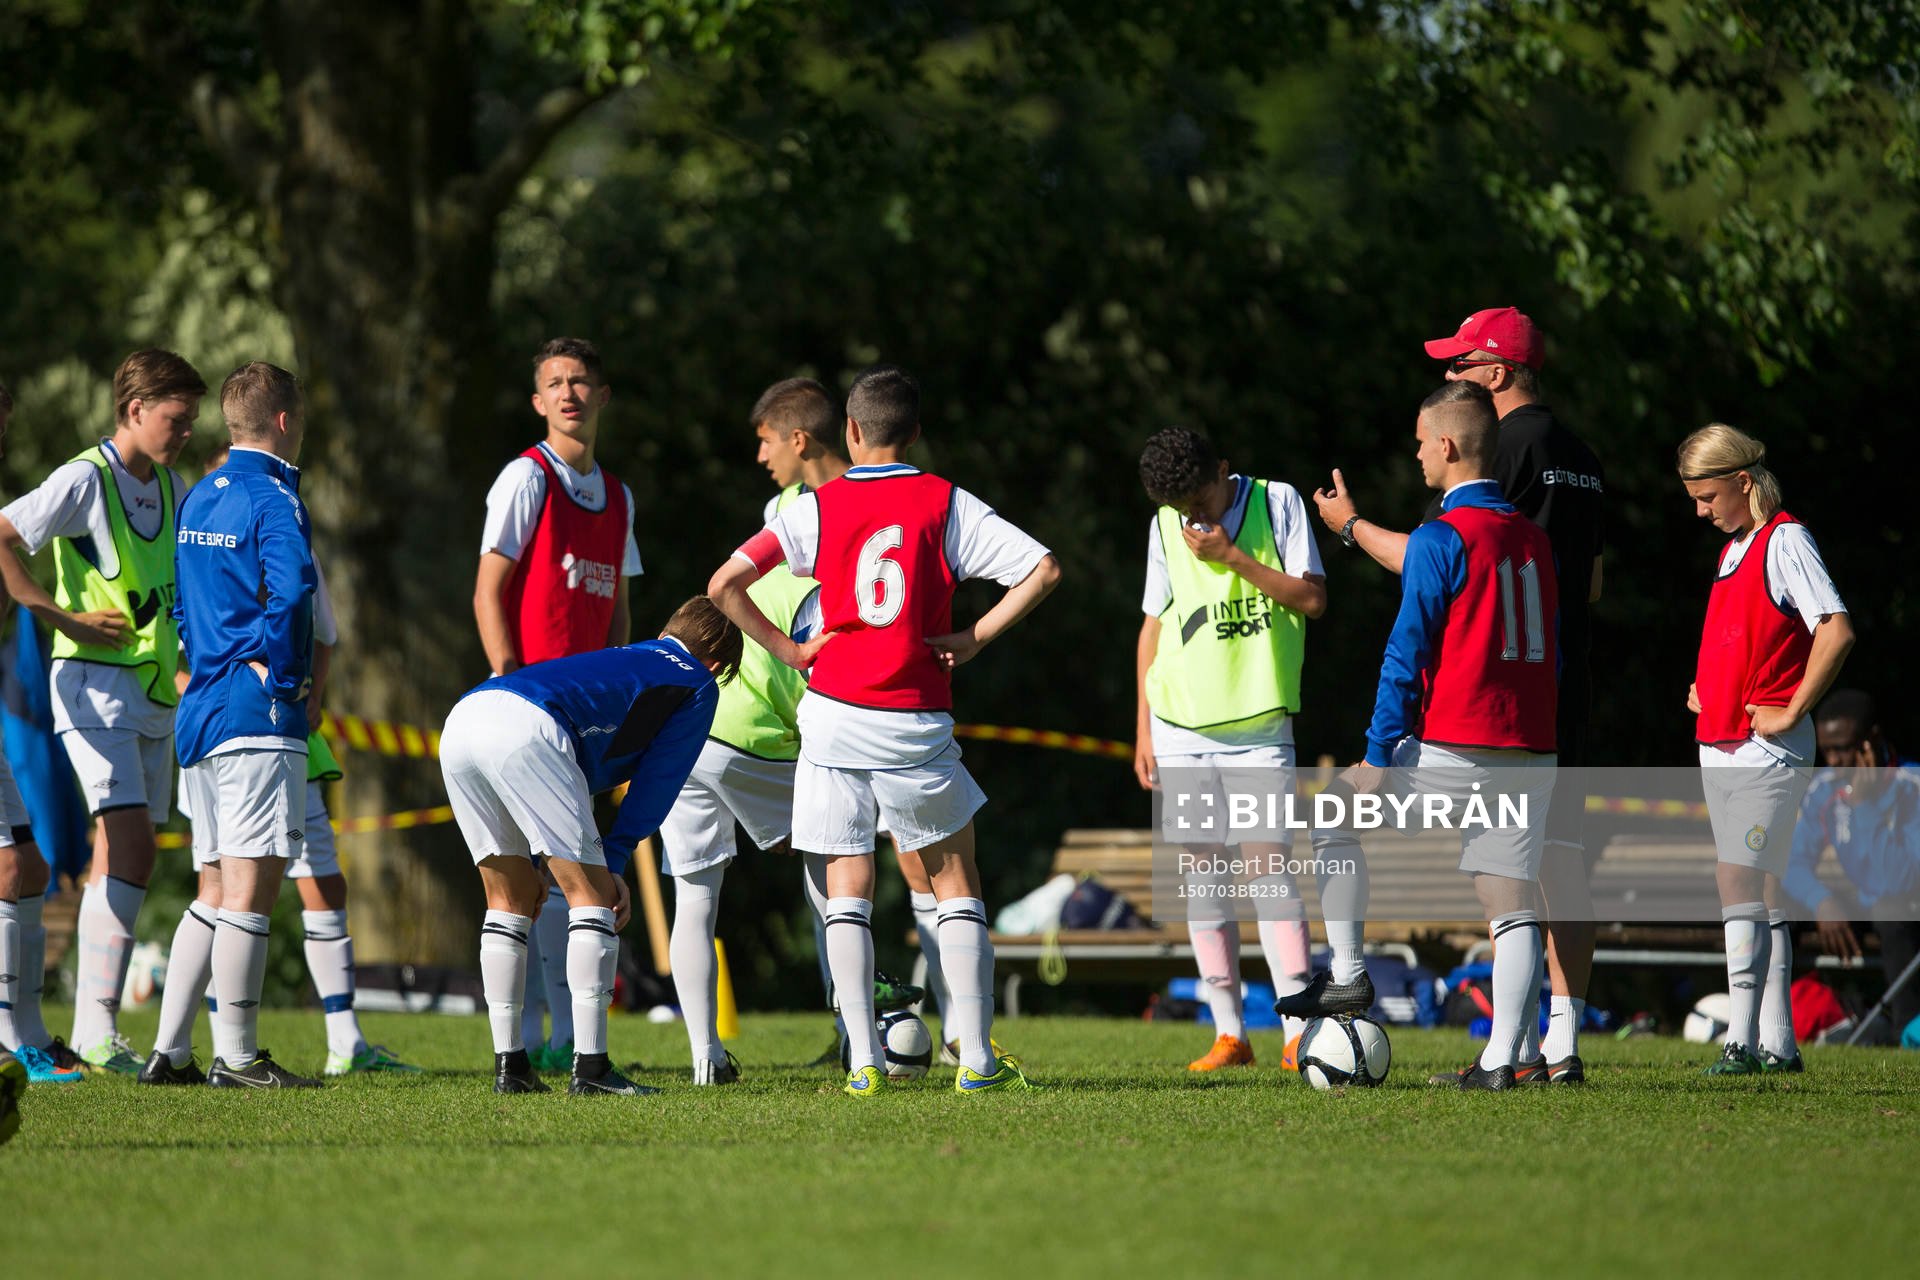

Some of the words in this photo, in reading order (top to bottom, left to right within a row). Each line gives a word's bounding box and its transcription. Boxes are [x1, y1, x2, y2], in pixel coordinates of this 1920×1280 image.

[855, 524, 905, 627] 6
[1213, 592, 1269, 620] INTER
[1215, 611, 1272, 640] SPORT
[1497, 556, 1545, 662] 11
